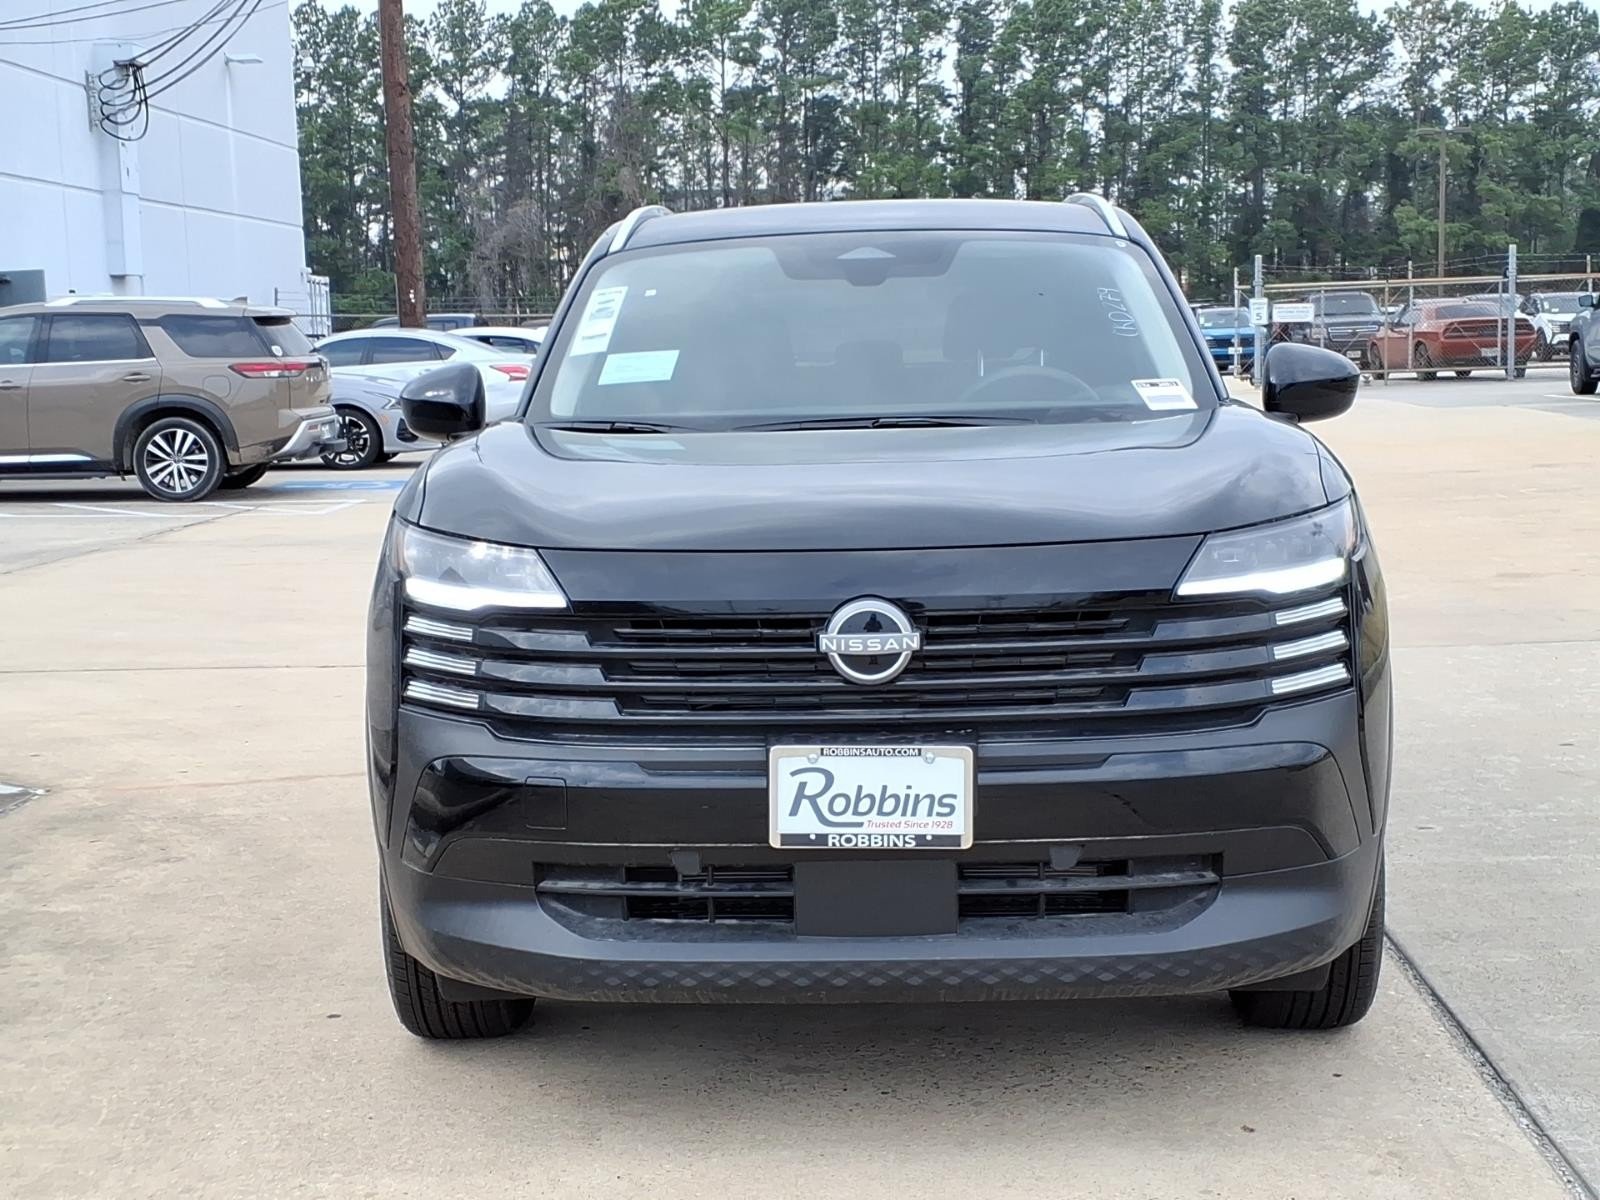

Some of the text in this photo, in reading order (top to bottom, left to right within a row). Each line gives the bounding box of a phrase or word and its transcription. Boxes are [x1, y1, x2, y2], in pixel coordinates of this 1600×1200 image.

[822, 636, 918, 651] NISSAN
[823, 748, 919, 756] ROBBINSAUTO.COM
[789, 767, 957, 828] Robbins
[867, 820, 953, 829] Trusted Since 1928
[828, 834, 916, 847] ROBBINS
